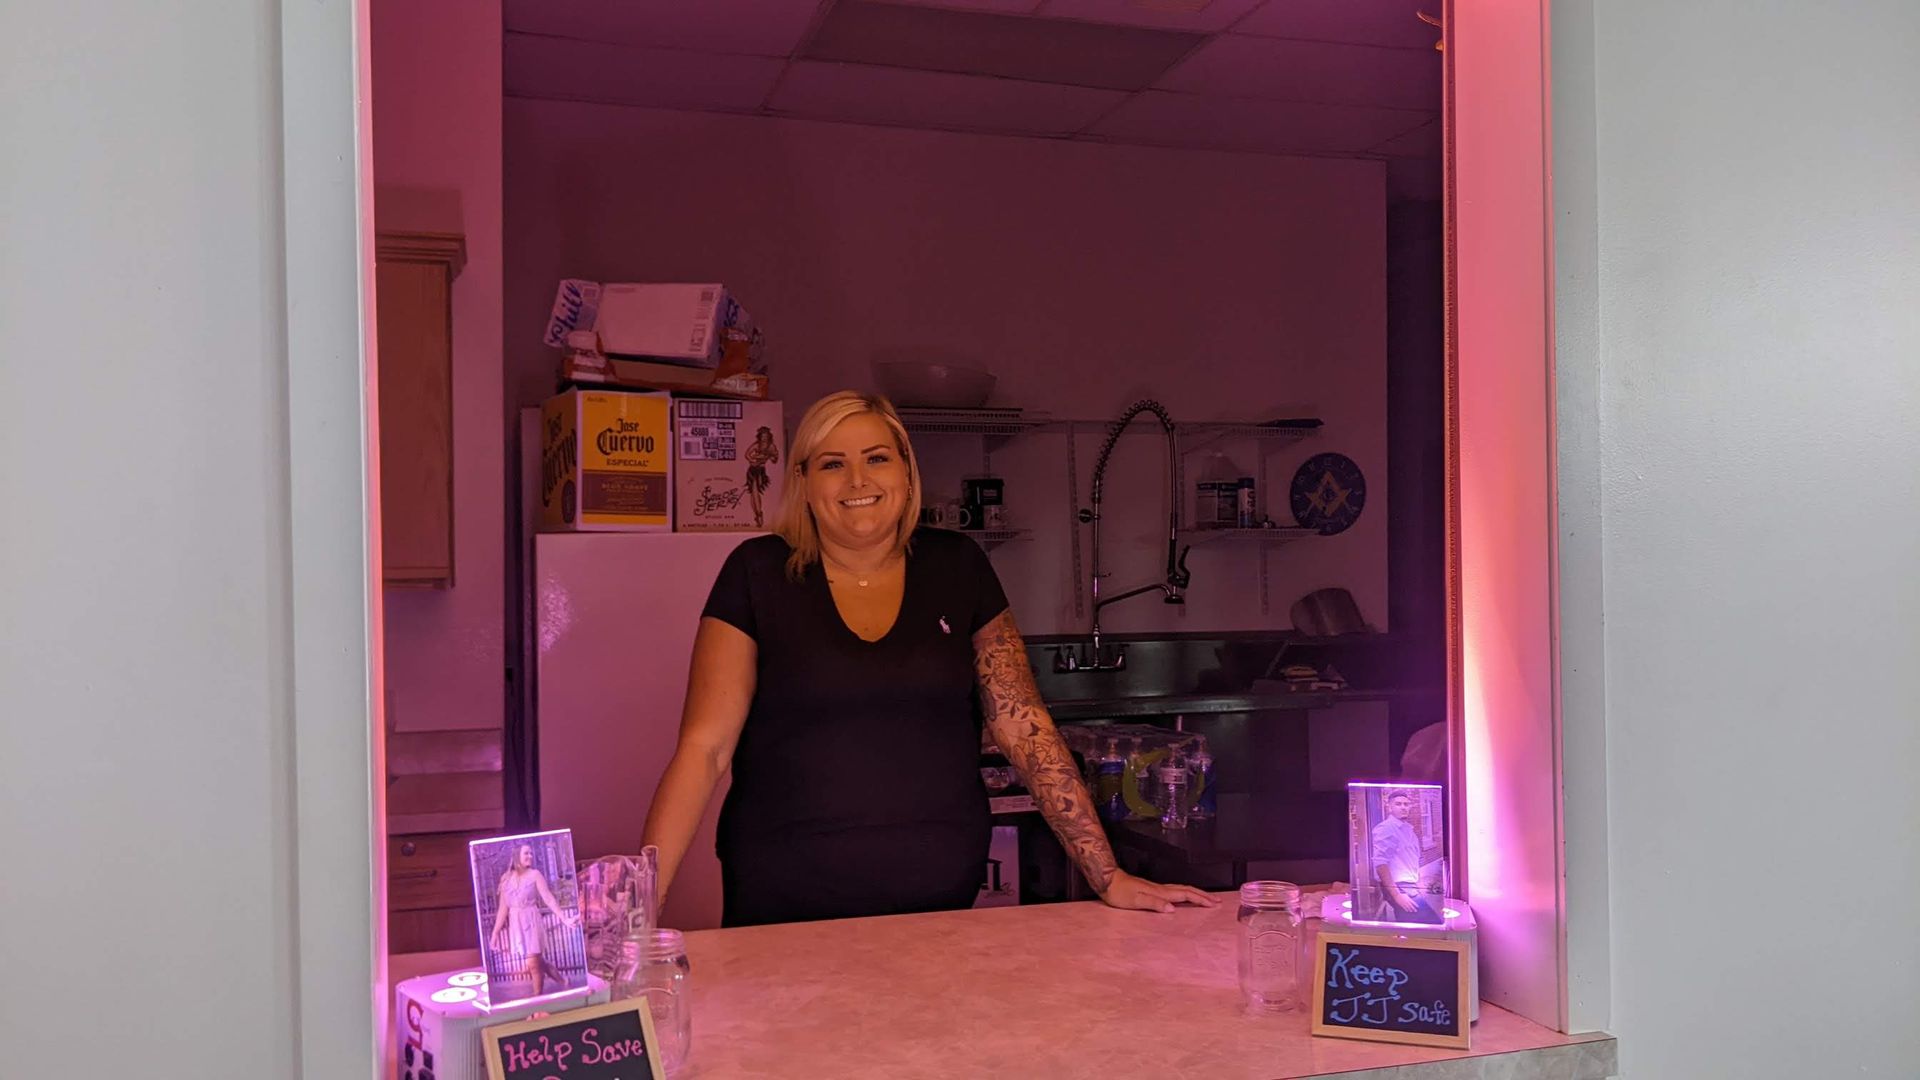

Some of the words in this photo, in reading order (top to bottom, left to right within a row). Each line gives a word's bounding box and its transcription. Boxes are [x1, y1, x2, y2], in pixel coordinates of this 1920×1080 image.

[616, 418, 640, 434] Jose
[597, 427, 654, 455] Cuervo
[606, 459, 648, 467] ESPECIAL
[1327, 948, 1409, 996] Keep
[504, 1035, 573, 1073] Help
[581, 1027, 644, 1066] Save
